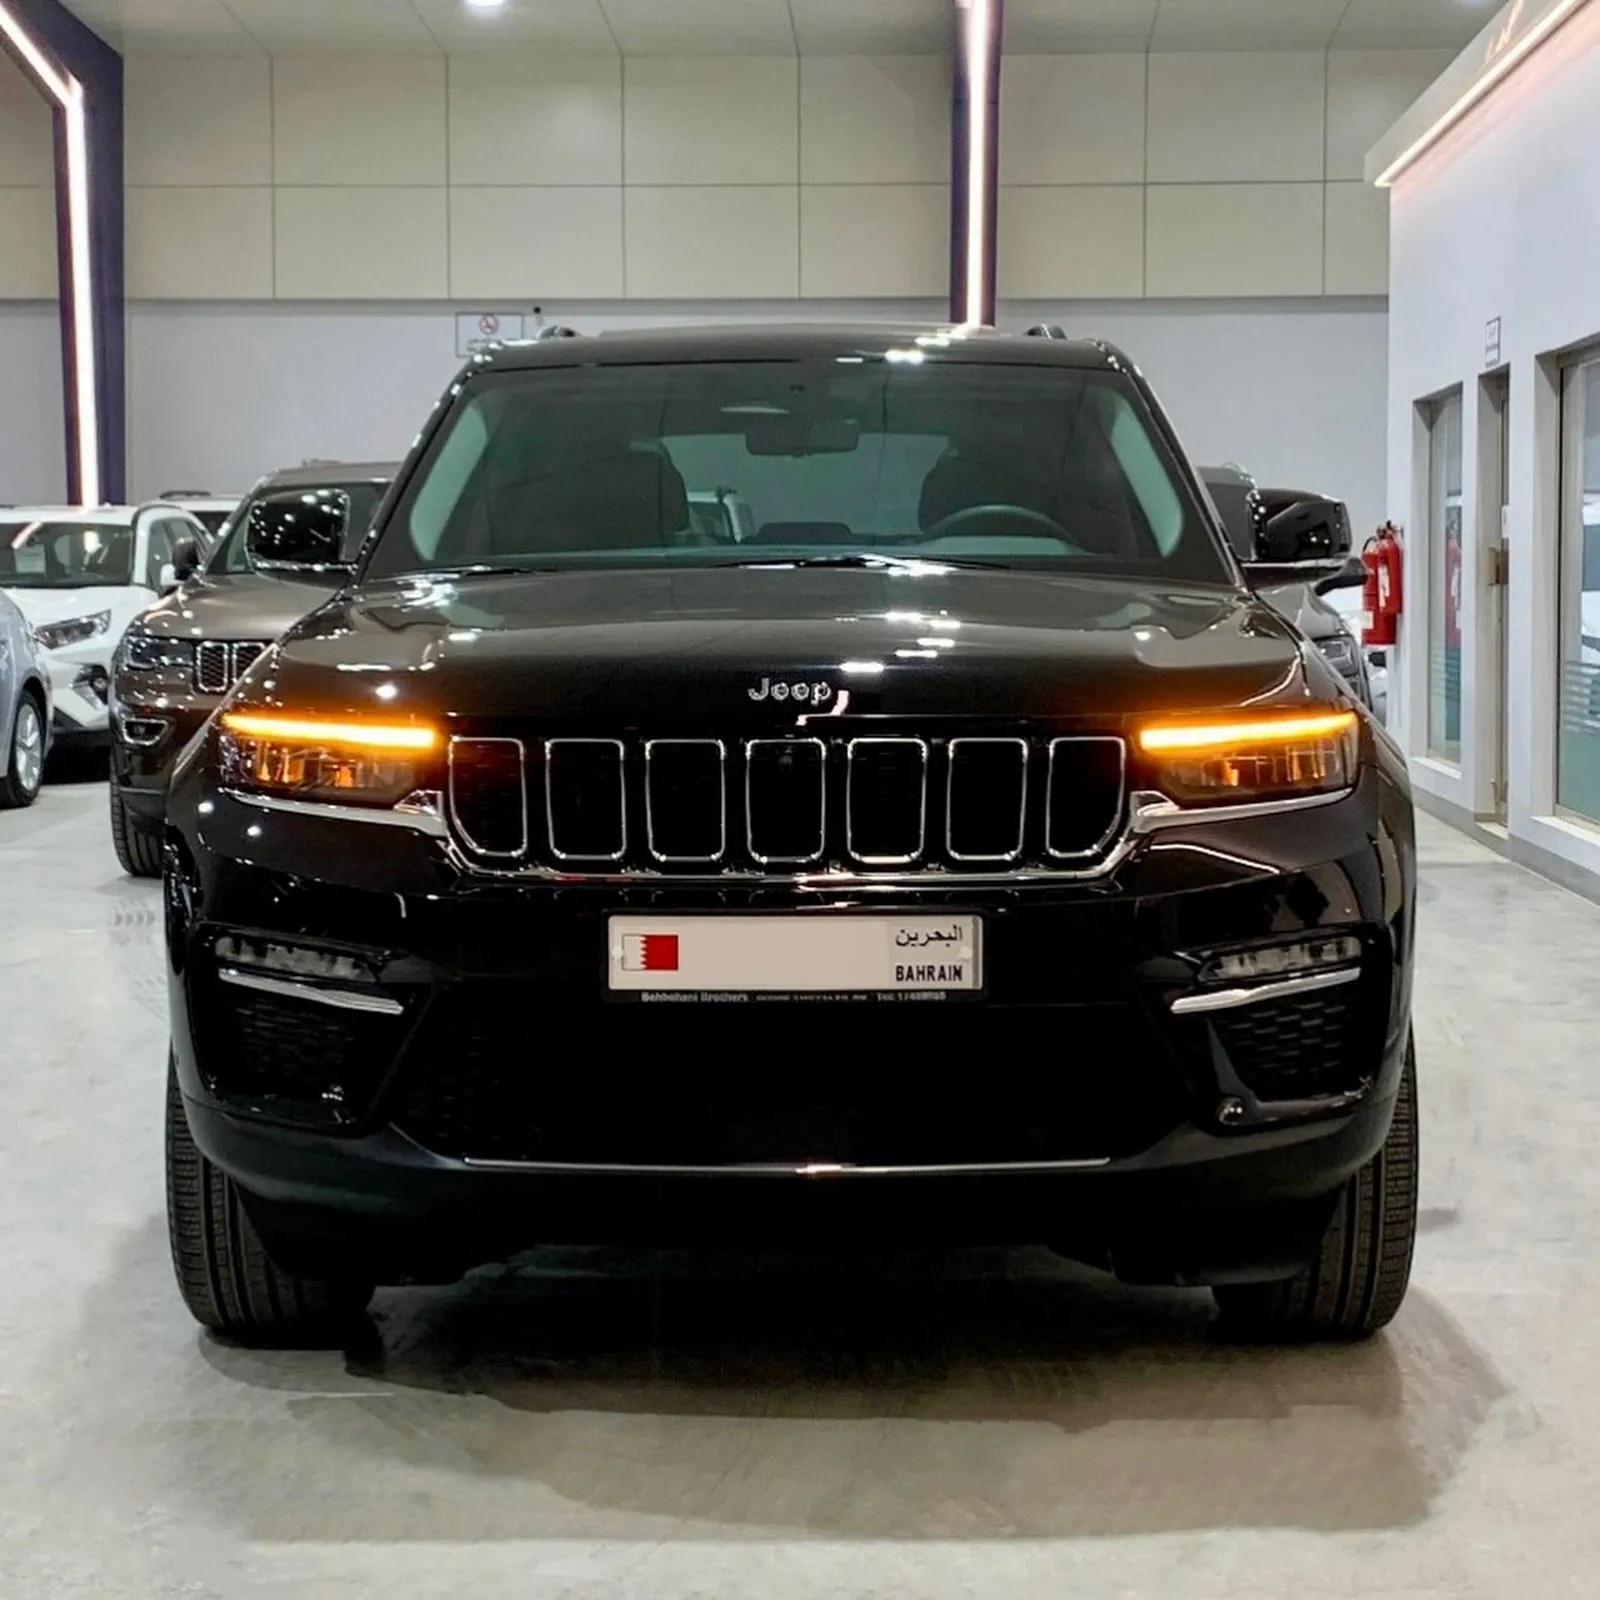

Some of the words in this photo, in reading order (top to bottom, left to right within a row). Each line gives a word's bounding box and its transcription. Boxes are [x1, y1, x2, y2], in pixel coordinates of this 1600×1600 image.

[747, 677, 831, 706] Jeep
[896, 924, 963, 947] البحرين
[896, 965, 963, 982] BAHRAIN
